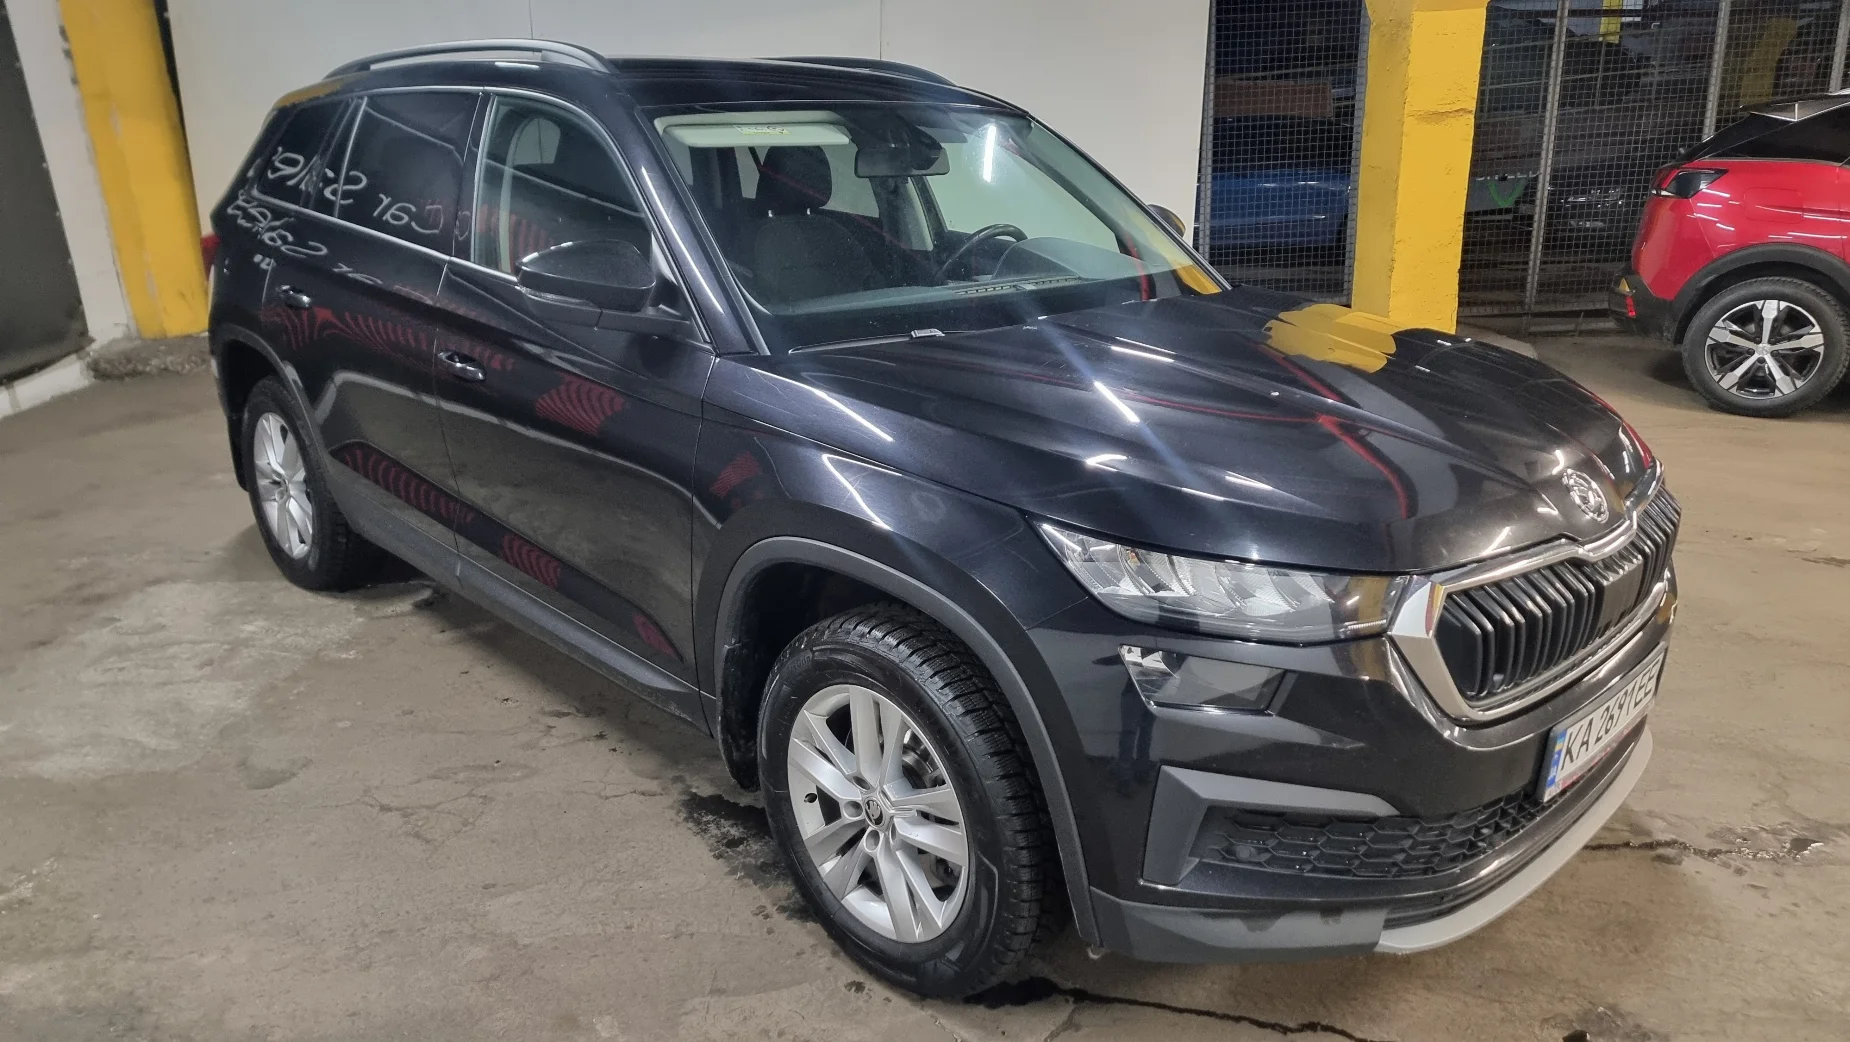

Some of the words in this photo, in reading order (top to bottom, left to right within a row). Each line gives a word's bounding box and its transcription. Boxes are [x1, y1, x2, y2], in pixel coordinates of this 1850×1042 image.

[1560, 717, 1594, 771] KA
[1595, 680, 1638, 745] 2691
[1633, 659, 1660, 708] EE
